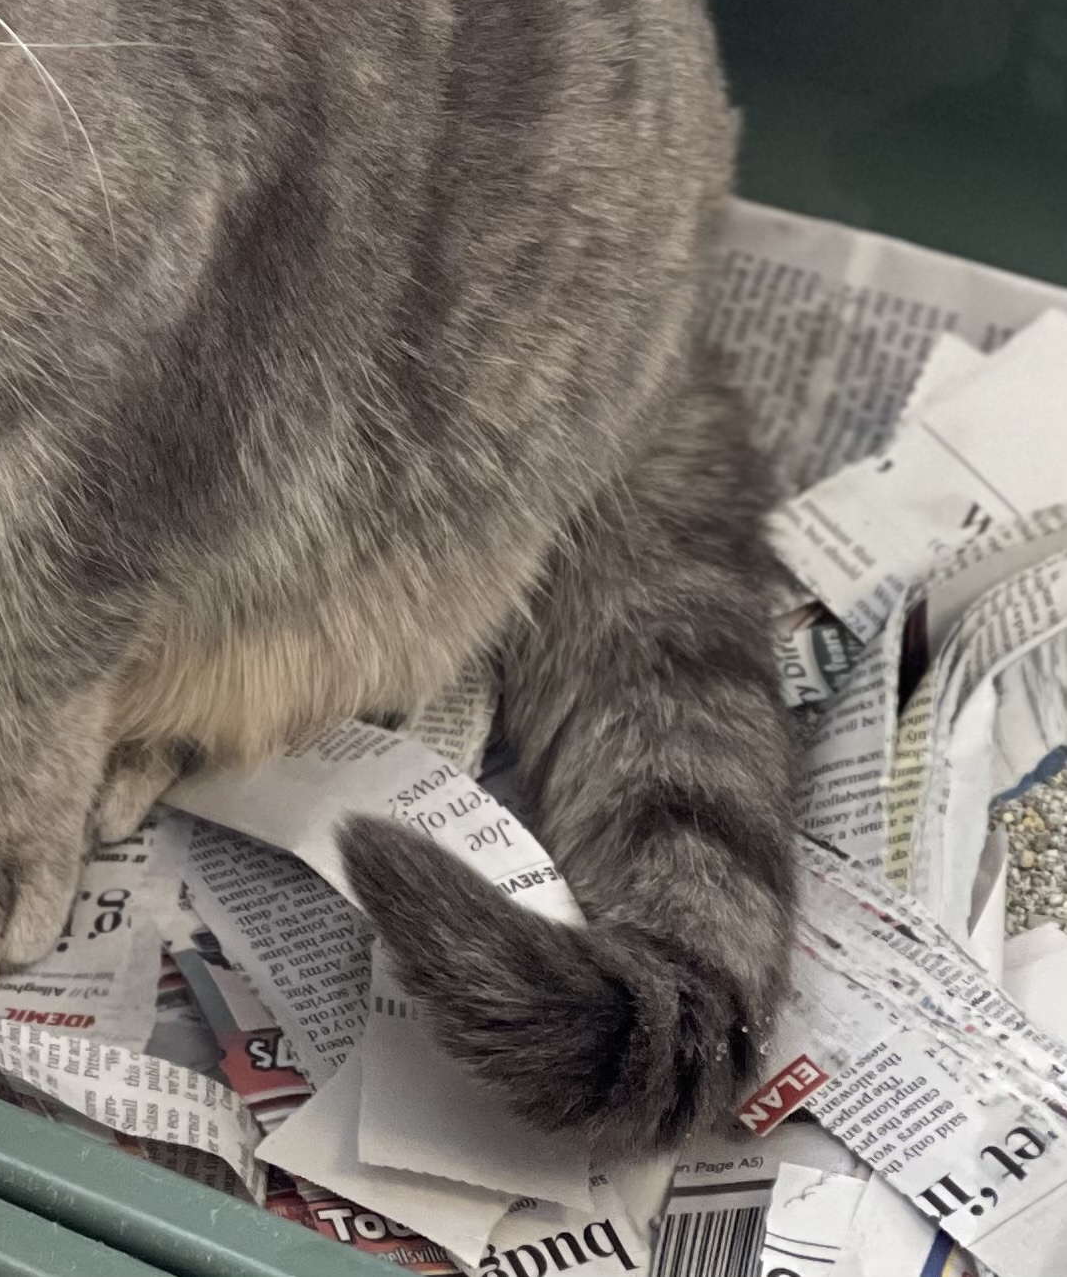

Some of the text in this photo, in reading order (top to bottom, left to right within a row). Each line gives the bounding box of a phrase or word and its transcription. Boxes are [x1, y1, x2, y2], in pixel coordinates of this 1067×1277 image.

[462, 815, 519, 862] Joe
[201, 857, 269, 886] the local
[208, 863, 283, 896] countless
[217, 882, 267, 907] Guard
[291, 880, 317, 898] the
[234, 907, 272, 929] dedi-
[276, 903, 287, 913] a
[299, 902, 332, 922] Post
[239, 921, 271, 940] 515,
[249, 910, 352, 952] he joined the
[272, 913, 298, 931] No.
[257, 923, 356, 964] After his time
[286, 939, 353, 968] Division
[268, 961, 285, 976] of
[272, 974, 291, 989] in
[296, 957, 342, 981] Army
[280, 981, 318, 1002] War,
[289, 981, 370, 1014] of service.
[297, 997, 367, 1029] Latrobe
[64, 1056, 79, 1074] for
[124, 1064, 139, 1087] this
[874, 1050, 903, 1077] the
[738, 1060, 822, 1133] ELAN
[870, 1071, 904, 1101] The
[104, 1095, 118, 1116] pro-
[858, 1071, 929, 1130] emptions
[898, 1085, 941, 1121] cause
[165, 1106, 178, 1128] eco-
[875, 1113, 904, 1140] the
[895, 1096, 955, 1145] earners
[934, 1109, 969, 1140] said
[900, 1130, 938, 1164] only
[695, 1159, 734, 1175] Page
[737, 1156, 765, 1170] A5)
